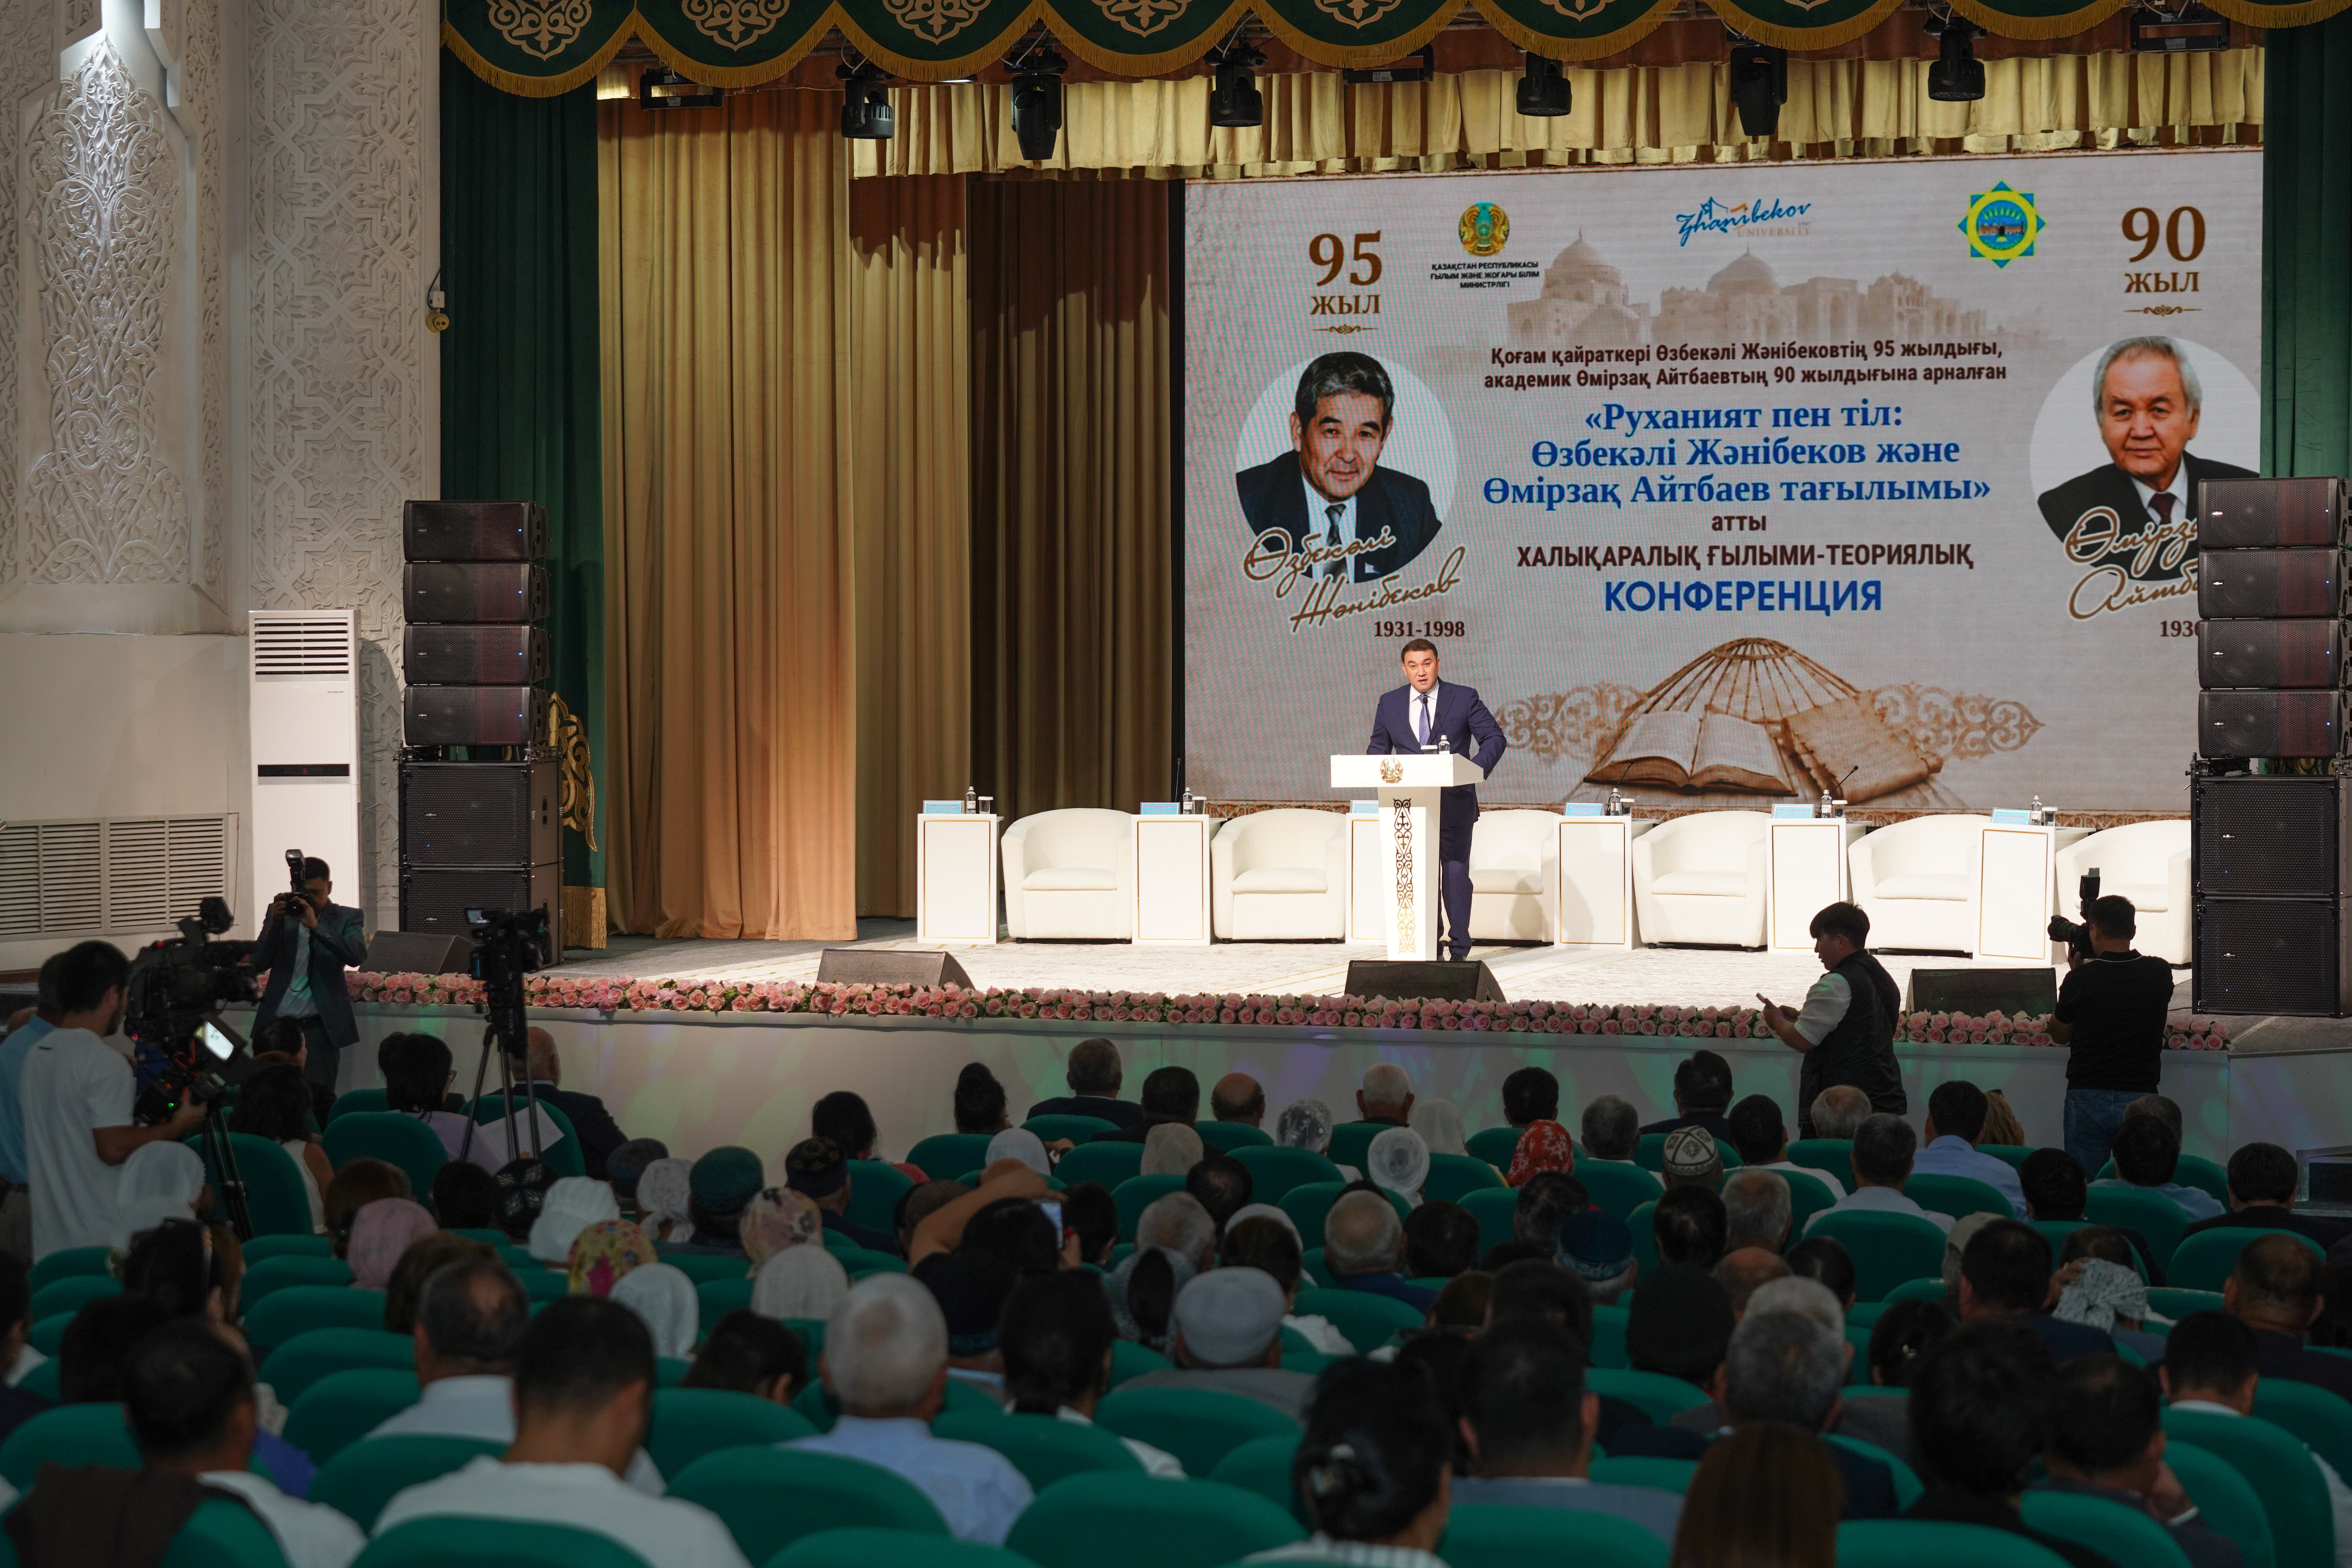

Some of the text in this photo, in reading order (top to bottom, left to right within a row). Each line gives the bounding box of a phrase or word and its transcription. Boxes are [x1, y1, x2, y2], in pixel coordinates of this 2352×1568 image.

[1736, 227, 1811, 237] UNIVERSITY
[2121, 206, 2205, 263] 90
[1309, 230, 1382, 286] 95
[2124, 272, 2200, 293] ЖЫЛ
[1310, 294, 1380, 315] ЖЫЛ
[1491, 341, 2002, 367] Қоғам қайраткері Өзбекәлі Жәнібековтің 95 жылдығы,
[1484, 365, 2006, 390] академик Өмірзақ Айтбаевтың 90 жылдығына арналған
[1585, 398, 1902, 437] «Руханият пен тіл:
[1532, 436, 1960, 467] Өзбекәлі Жәнібеков және
[1484, 474, 1990, 511] Өмірзақ Айтбаев тағылымы»
[1711, 515, 1767, 531] атты
[1517, 544, 1974, 570] ХАЛЫҚАРАЛЫҚ ҒЫЛЫМИ-ТЕОРИЯЛЫҚ
[1605, 580, 1882, 616] КОНФЕРЕНЦИЯ
[1374, 621, 1465, 637] 1931-1998
